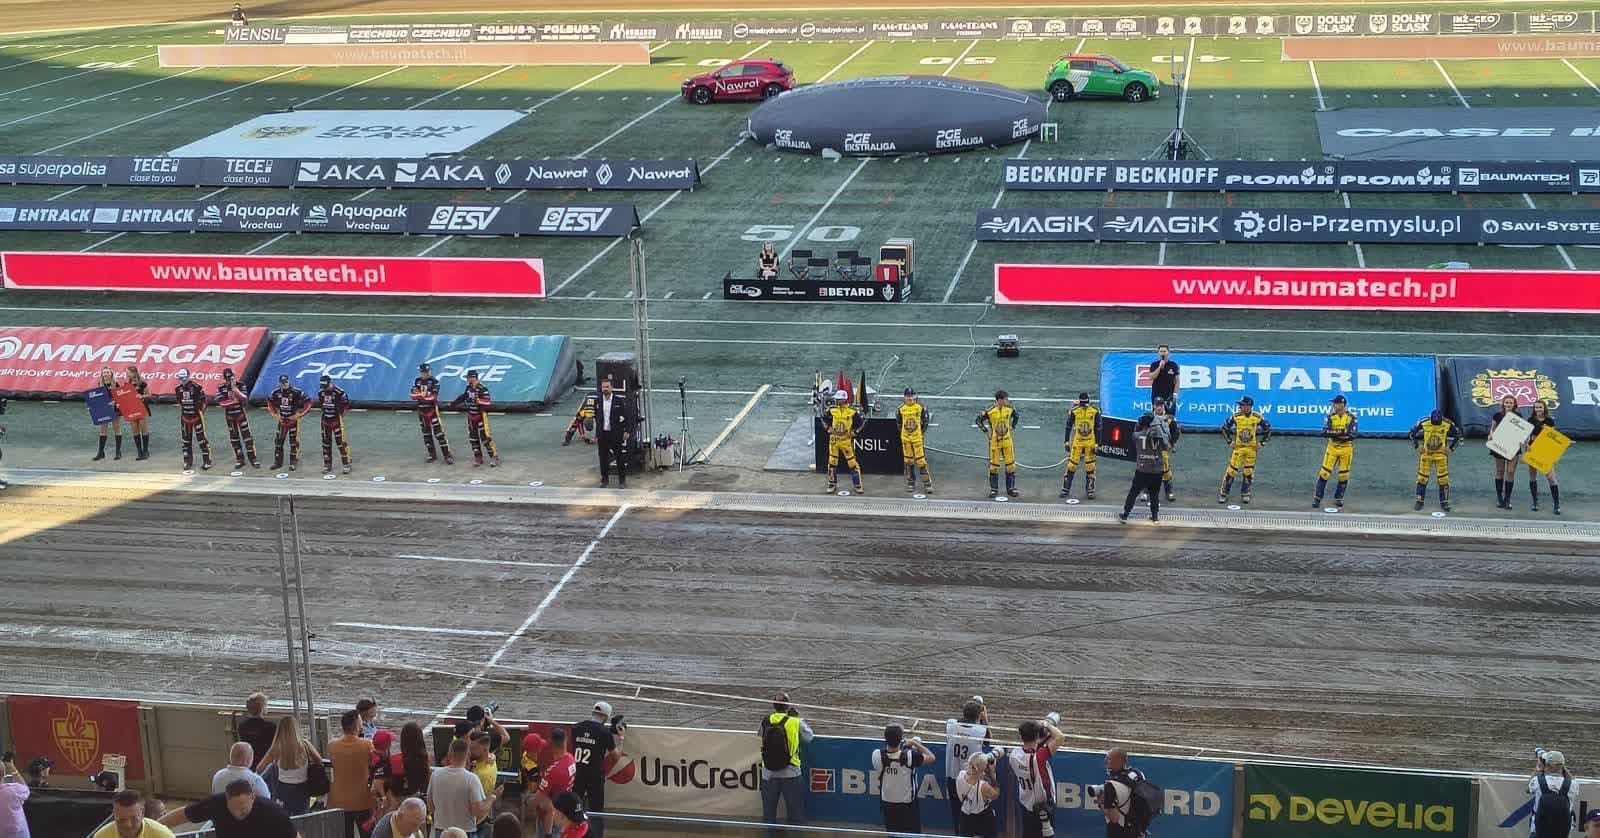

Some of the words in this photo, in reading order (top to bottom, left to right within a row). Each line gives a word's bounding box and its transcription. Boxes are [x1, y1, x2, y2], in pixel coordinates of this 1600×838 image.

[1317, 16, 1357, 24] DOLNY
[1392, 14, 1432, 23] DOLNY
[226, 28, 283, 41] MENSIL
[715, 79, 759, 94] Nawrot
[845, 133, 871, 144] PGE
[936, 129, 962, 141] PGE
[1336, 128, 1555, 137] CASE
[845, 142, 896, 152] EKSTRALIGA
[936, 136, 984, 148] EKSTRALIGA
[18, 161, 107, 178] superpolisa
[133, 158, 172, 172] TECE
[226, 159, 265, 173] TECE
[322, 164, 386, 181] AKA
[420, 165, 485, 181] AKA
[130, 174, 151, 182] close
[151, 174, 160, 182] to
[161, 175, 177, 184] you
[223, 174, 244, 183] close
[245, 174, 254, 183] to
[254, 176, 270, 184] you
[525, 166, 589, 182] Nawrot
[627, 166, 690, 182] Nawrot
[1005, 165, 1107, 183] BECKHOFF
[1115, 167, 1219, 184] BECKHOFF
[1480, 173, 1570, 181] BAUMATECH
[18, 208, 91, 222] ENTRACK
[121, 208, 195, 223] ENTRACK
[225, 203, 300, 220] Aquapark
[331, 203, 408, 221] Aquapark
[741, 224, 862, 242] 50
[1268, 215, 1461, 237] dla-Przemyslu.pl
[150, 262, 386, 288] www.baumatech.pl
[828, 287, 875, 297] BETARD
[1171, 275, 1457, 304] www.baumatech.pl
[19, 342, 250, 365] IMMERGAS
[296, 362, 374, 380] PGE
[436, 364, 513, 382] PGE
[1180, 364, 1393, 392] BETARD
[1258, 404, 1272, 414] W
[574, 747, 591, 764] 02
[953, 743, 969, 760] 03
